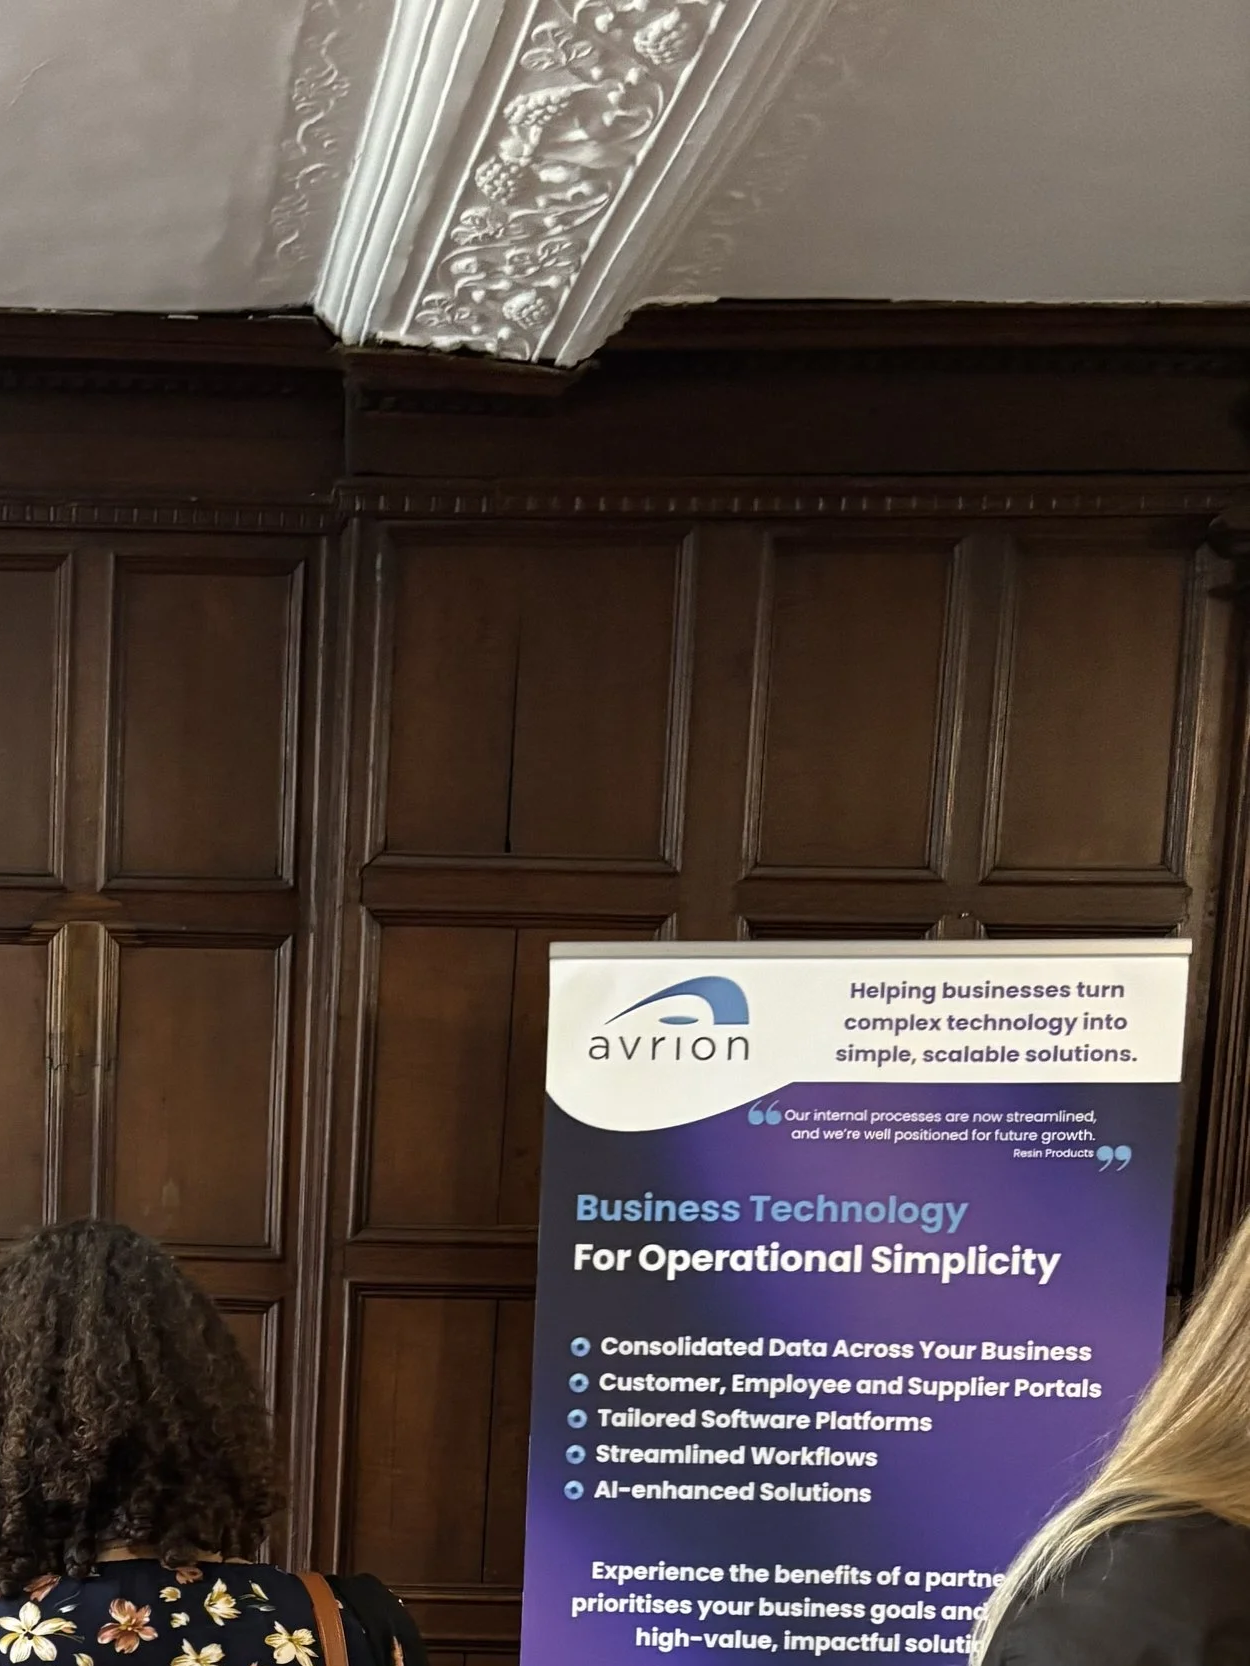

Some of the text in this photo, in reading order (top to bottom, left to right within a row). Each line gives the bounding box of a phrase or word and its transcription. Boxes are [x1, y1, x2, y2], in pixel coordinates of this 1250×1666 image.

[851, 980, 1124, 1004] Helping businesses turn
[844, 1012, 1127, 1036] complex technology into
[589, 1036, 749, 1060] avrion
[836, 1044, 1137, 1067] simple, scalable solutions.
[785, 1109, 1096, 1124] Our internal processes are now streamlined,
[791, 1128, 1095, 1144] and we're well positioned for future growth.
[1014, 1149, 1094, 1157] Resin Products
[577, 1192, 968, 1233] Business Technology
[574, 1242, 1061, 1284] For Operational Simplicity
[601, 1336, 1091, 1361] Consolidated Data Across Your Business
[599, 1373, 1101, 1401] Customer, Employee and Supplier Portals
[598, 1407, 932, 1431] Tailored Software Platforms
[596, 1444, 878, 1466] Streamlined Workflows
[594, 1480, 871, 1502] AI-enhanced Solutions
[592, 1561, 724, 1585] Experience
[729, 1564, 769, 1583] the
[775, 1565, 871, 1585] benefits
[877, 1566, 901, 1585] of
[905, 1572, 920, 1585] a
[572, 1593, 692, 1617] prioritises
[697, 1600, 754, 1620] your
[759, 1597, 865, 1618] business
[870, 1601, 936, 1624] goals
[636, 1627, 777, 1652] high-value,
[784, 1630, 900, 1656] impactful
